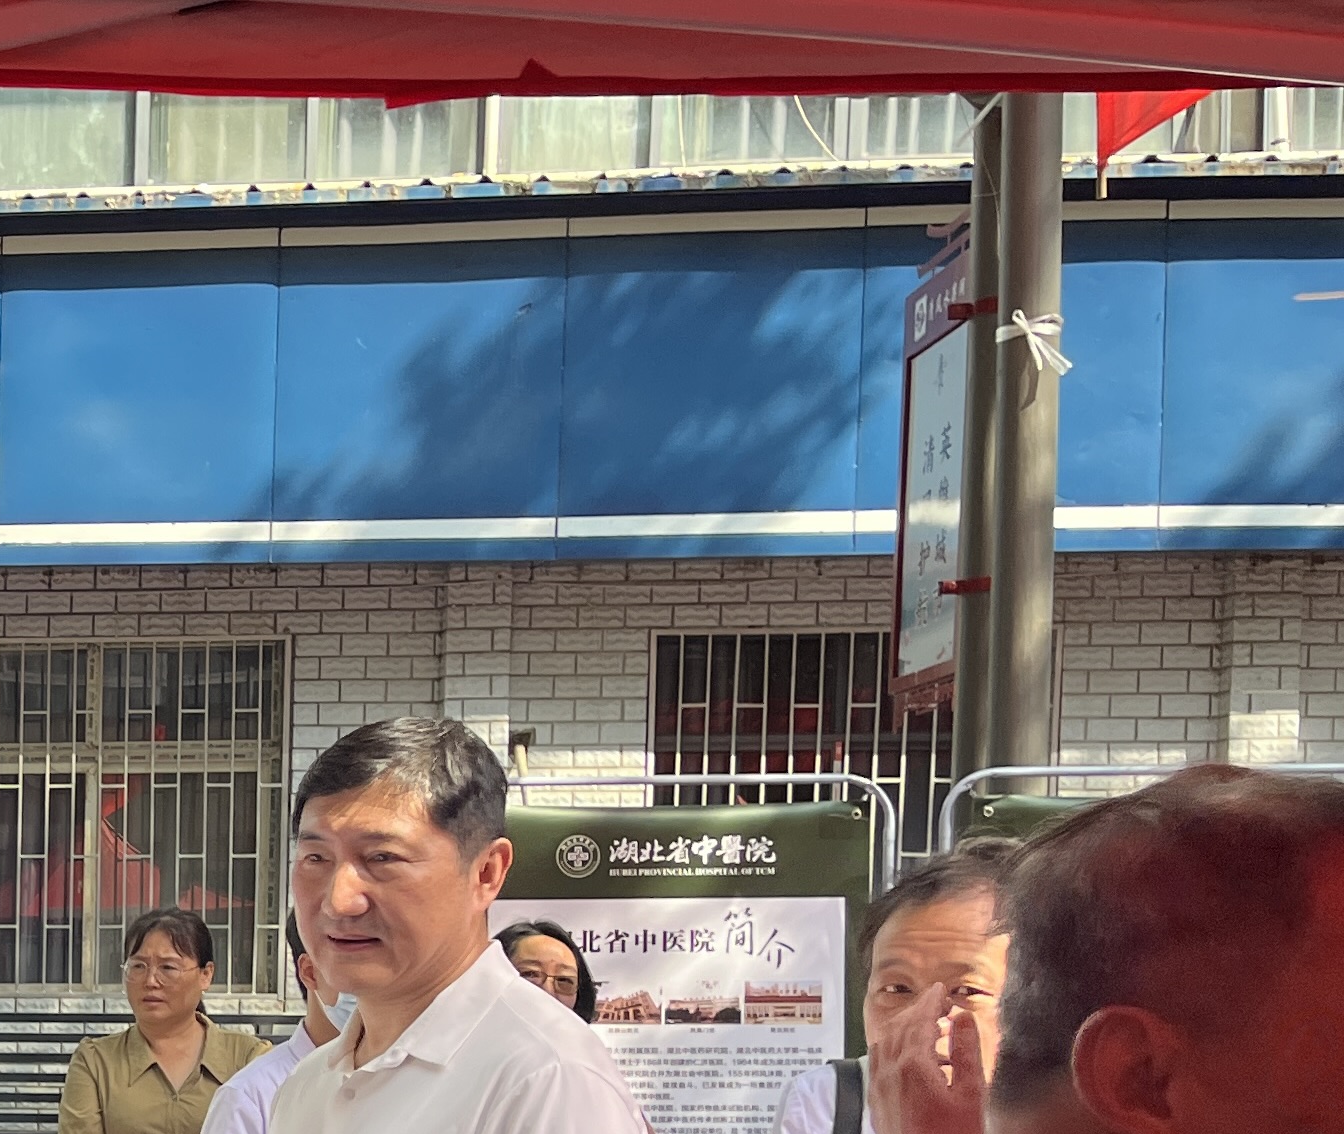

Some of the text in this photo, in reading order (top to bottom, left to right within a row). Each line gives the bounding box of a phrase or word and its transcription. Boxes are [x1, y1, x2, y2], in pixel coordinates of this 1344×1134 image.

[609, 867, 776, 877] HUBEI PROVINCIAL HOSPITAL OF TCM
